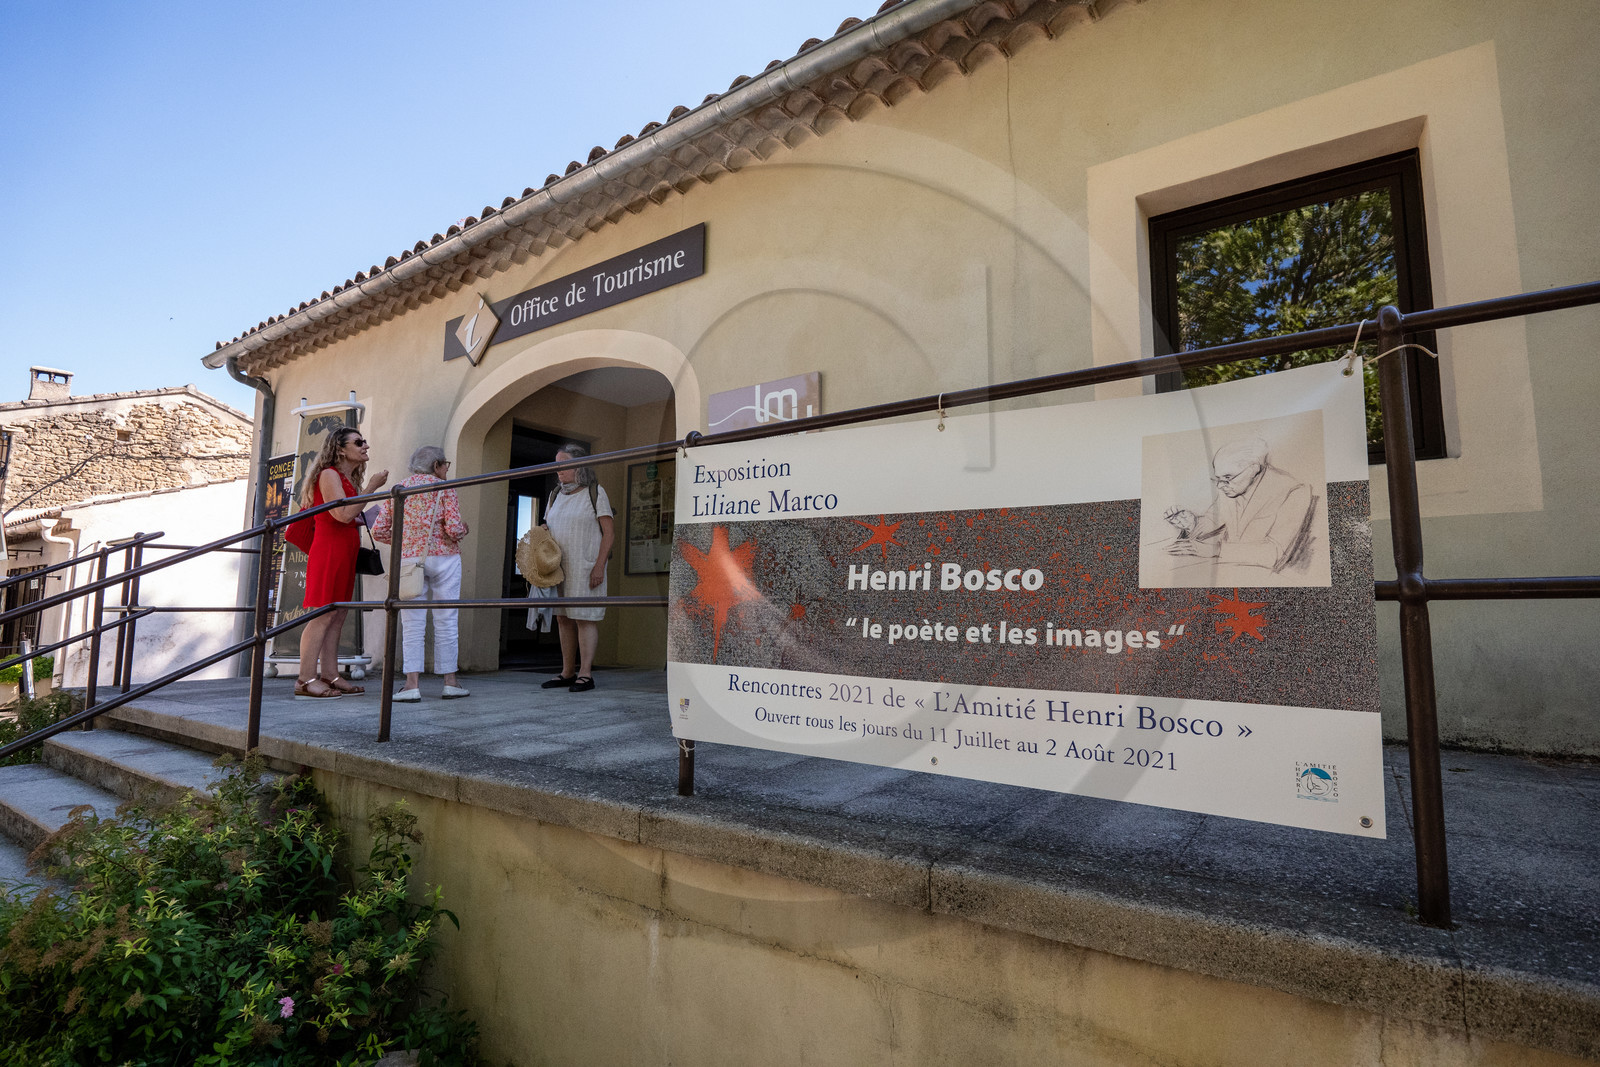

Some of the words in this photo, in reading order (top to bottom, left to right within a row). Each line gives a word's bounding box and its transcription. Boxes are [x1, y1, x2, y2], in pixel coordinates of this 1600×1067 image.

[510, 297, 559, 327] Office
[565, 283, 586, 307] de
[593, 250, 685, 297] Tourisme
[693, 458, 791, 488] Exposition
[692, 494, 761, 517] Liliane
[768, 489, 838, 513] Marco
[847, 562, 932, 591] Henri
[940, 562, 1044, 592] Bosco
[862, 617, 882, 639] le
[888, 619, 959, 645] poète
[965, 623, 992, 644] et
[1000, 620, 1038, 645] les
[1046, 623, 1161, 655] images
[727, 673, 823, 700] Rencontres
[829, 682, 873, 705] 2021
[882, 687, 906, 708] de
[1046, 699, 1125, 728] Henri
[1136, 706, 1223, 737] Bosco
[754, 706, 801, 726] Ouvert
[805, 716, 834, 731] tous
[838, 715, 858, 733] les
[861, 720, 898, 738] jours
[903, 723, 923, 742] du
[930, 726, 948, 744] 11
[953, 728, 1010, 751] Juillet
[1016, 740, 1039, 754] au
[1045, 738, 1057, 756] 2
[1064, 740, 1115, 764] Août
[1123, 747, 1178, 771] 2021
